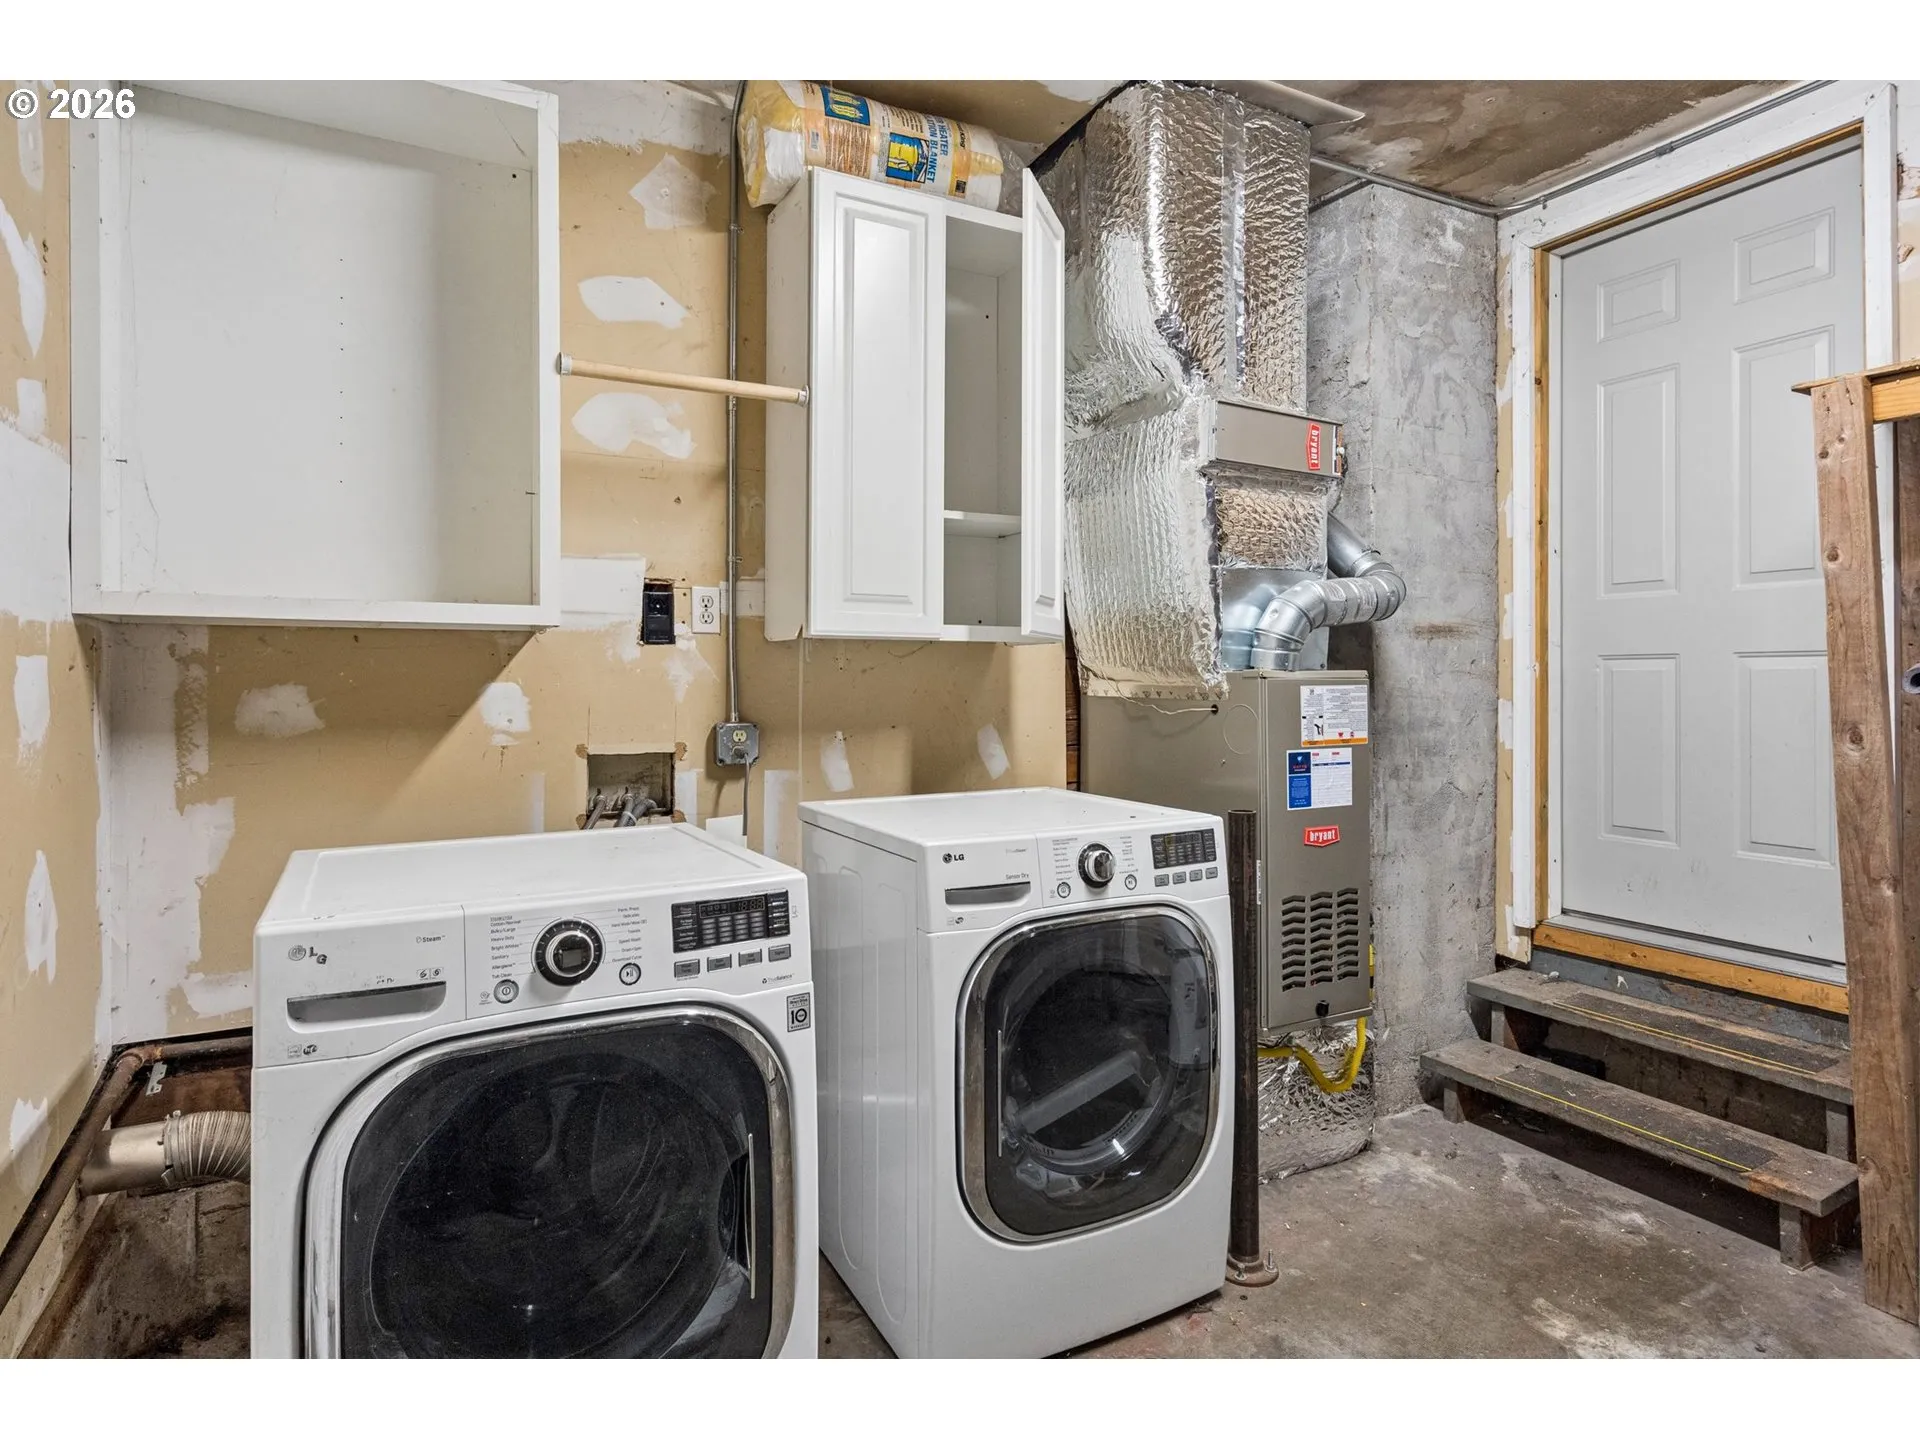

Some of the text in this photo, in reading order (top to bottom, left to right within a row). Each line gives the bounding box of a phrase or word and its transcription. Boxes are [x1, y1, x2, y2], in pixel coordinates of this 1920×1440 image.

[938, 124, 949, 156] HEATER
[926, 139, 938, 184] BLANKET
[1311, 430, 1319, 463] bryant
[1309, 829, 1336, 843] bryant
[953, 853, 965, 861] LG
[791, 1008, 808, 1025] 10
